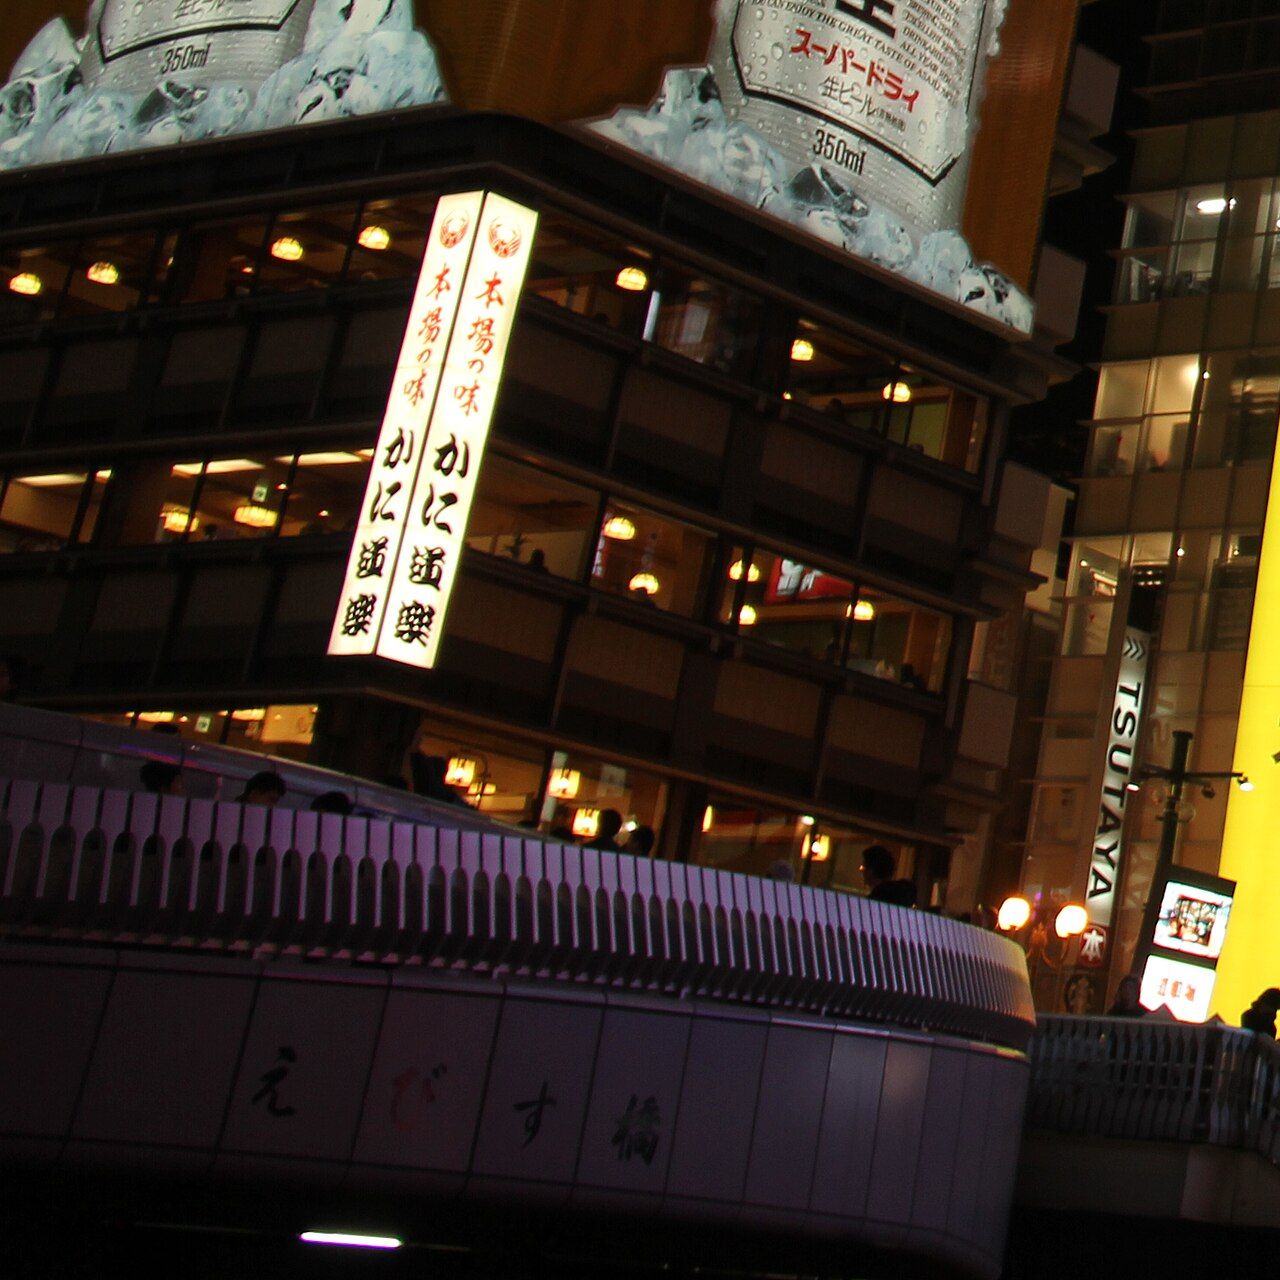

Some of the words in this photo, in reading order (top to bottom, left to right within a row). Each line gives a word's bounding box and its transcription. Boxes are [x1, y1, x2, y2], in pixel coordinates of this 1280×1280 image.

[162, 42, 211, 75] 350ml
[790, 29, 921, 113] スーパードライ
[812, 128, 866, 176] 350ml
[403, 263, 454, 407] 本場の味
[454, 273, 504, 417] 本場の味
[1088, 682, 1141, 900] TSUTAYA
